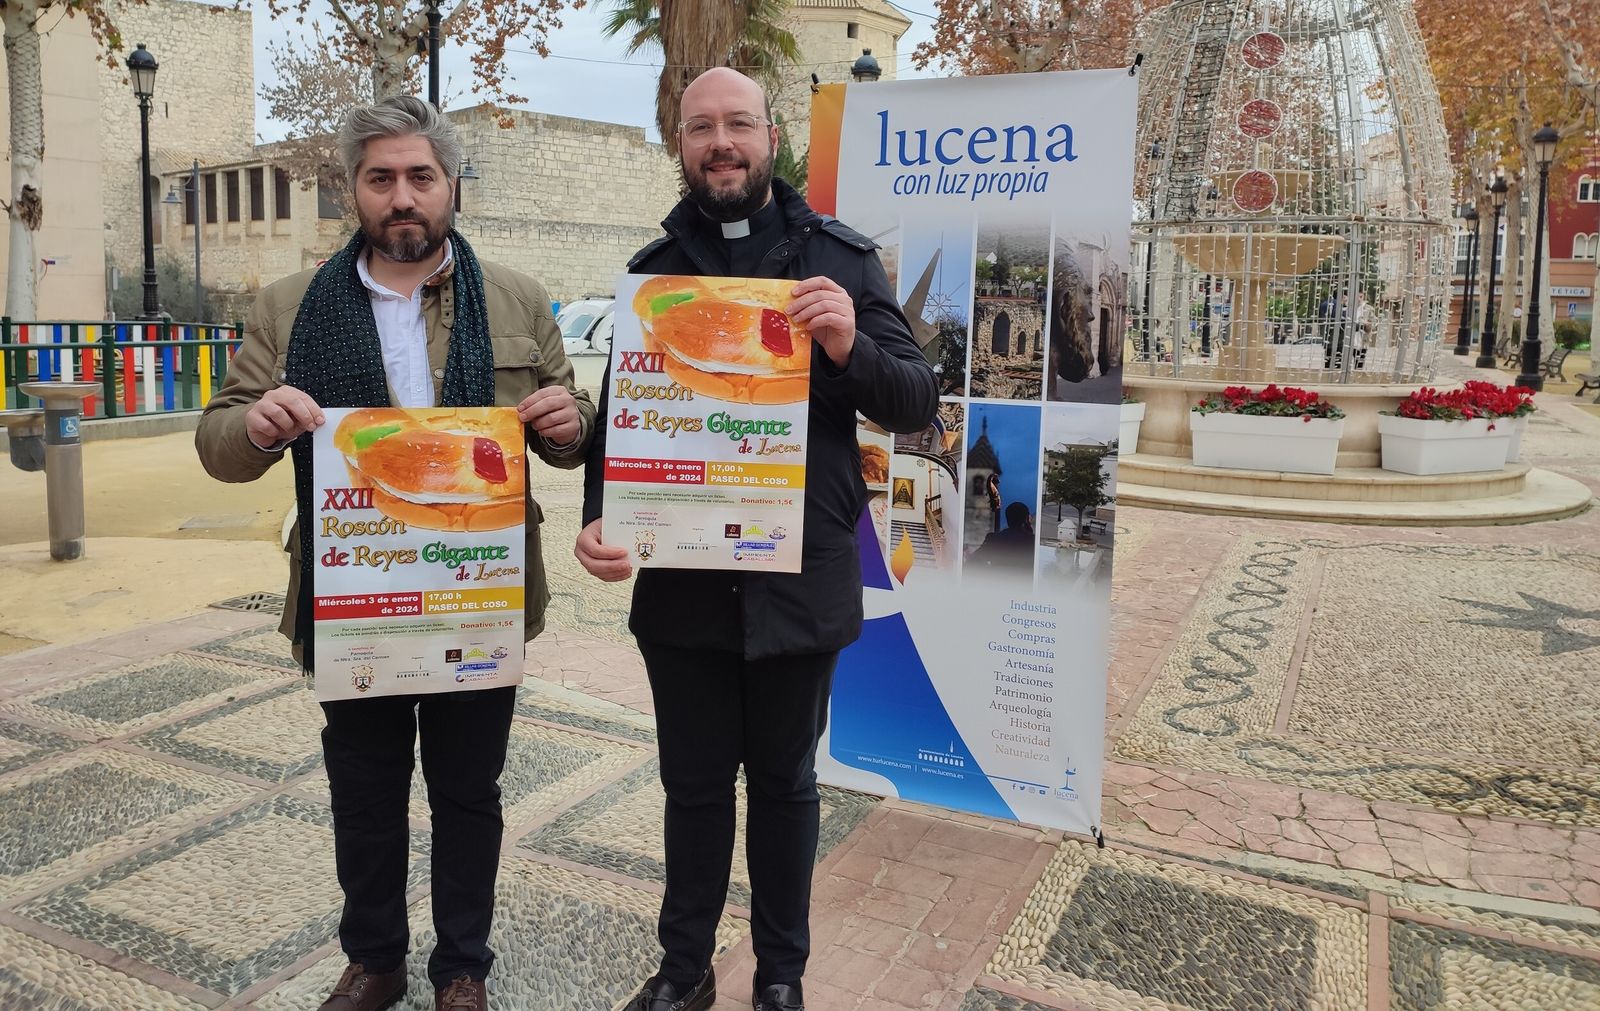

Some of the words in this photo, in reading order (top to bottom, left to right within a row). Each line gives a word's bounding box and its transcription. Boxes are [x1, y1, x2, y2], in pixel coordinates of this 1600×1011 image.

[875, 110, 1078, 167] lucena
[893, 174, 931, 195] con
[935, 166, 970, 194] luz
[970, 165, 1049, 201] propia
[616, 351, 666, 373] XXII
[614, 377, 694, 401] Roscón
[613, 408, 640, 430] de
[641, 409, 703, 438] Reyes
[706, 411, 792, 441] Gigante
[738, 438, 753, 454] de
[756, 437, 802, 456] Lucena
[608, 460, 653, 470] Miércoles
[662, 462, 674, 470] de
[711, 465, 736, 473] 17,00
[738, 465, 744, 473] h
[666, 473, 677, 481] de
[679, 474, 702, 482] 2024
[711, 475, 741, 484] PASEO
[743, 476, 761, 485] DEL
[763, 477, 789, 486] COSO
[321, 487, 374, 511] XXII
[741, 497, 775, 505] Donativo:
[320, 515, 407, 539] Roscón
[320, 546, 349, 567] de
[352, 545, 418, 572] Reyes
[422, 541, 509, 569] Gigante
[455, 566, 470, 581] de
[474, 562, 520, 581] Lucena
[318, 597, 366, 607] Miércoles
[391, 595, 419, 603] enero
[428, 592, 454, 602] 17,00
[456, 592, 462, 600] h
[381, 606, 393, 614] de
[395, 605, 419, 614] 2024
[428, 603, 459, 611] PASEO
[462, 601, 480, 610] DEL
[482, 600, 508, 609] COSO
[1010, 600, 1057, 615] Industria
[1002, 614, 1057, 630] Congresos
[1008, 629, 1056, 644] Compras
[988, 641, 1055, 659] Gastronomía
[1005, 658, 1054, 674] Artesanía
[994, 671, 1054, 689] Tradiciones
[995, 686, 1053, 703] Patrimonio
[989, 700, 1052, 721] Arqueología
[1010, 717, 1051, 733] Historia
[991, 729, 1051, 748] Creatividad
[995, 744, 1050, 762] Naturaleza
[857, 755, 912, 770] www.turlucena.com
[921, 766, 964, 779] www.lucena.es
[1054, 787, 1079, 799] lucena
